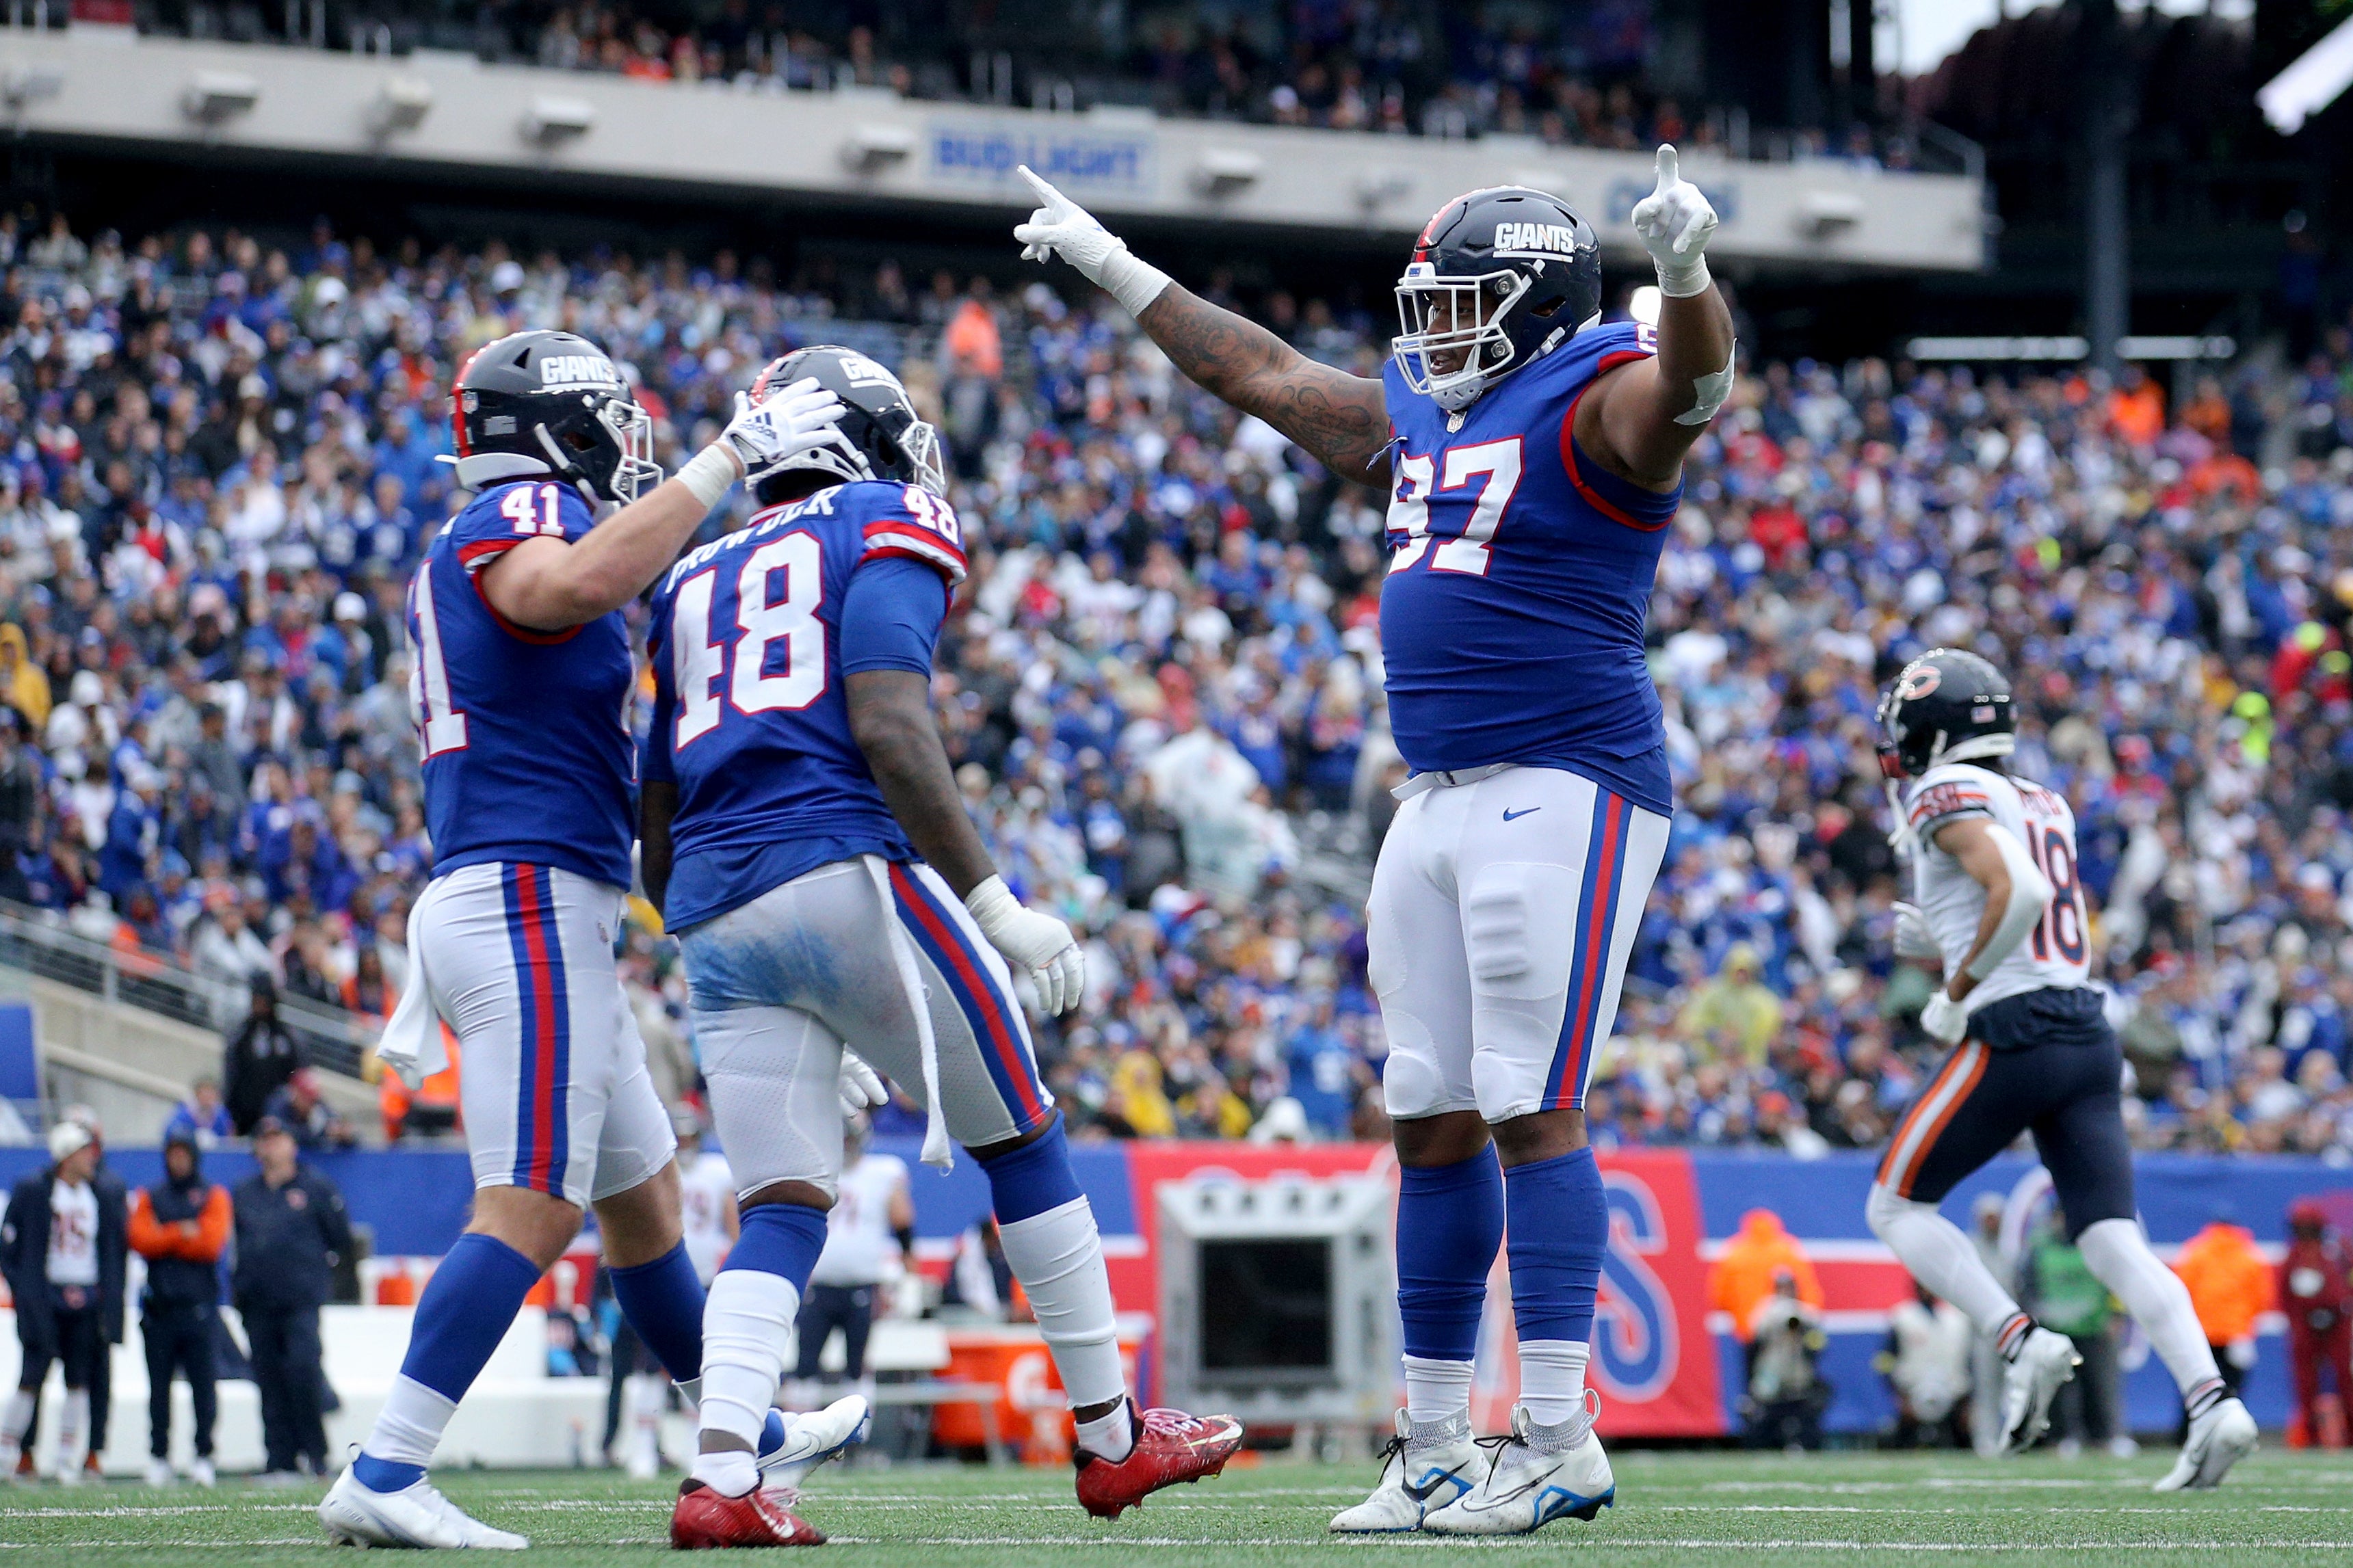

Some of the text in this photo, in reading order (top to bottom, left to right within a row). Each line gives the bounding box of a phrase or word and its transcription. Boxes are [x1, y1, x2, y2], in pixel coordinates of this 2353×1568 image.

[1494, 222, 1574, 253] GIANTS
[540, 356, 617, 384] GIANTS
[500, 483, 565, 536] 41
[902, 484, 960, 546] 48
[1384, 434, 1525, 576] 97
[672, 528, 830, 753] 48
[2027, 820, 2085, 965] 18
